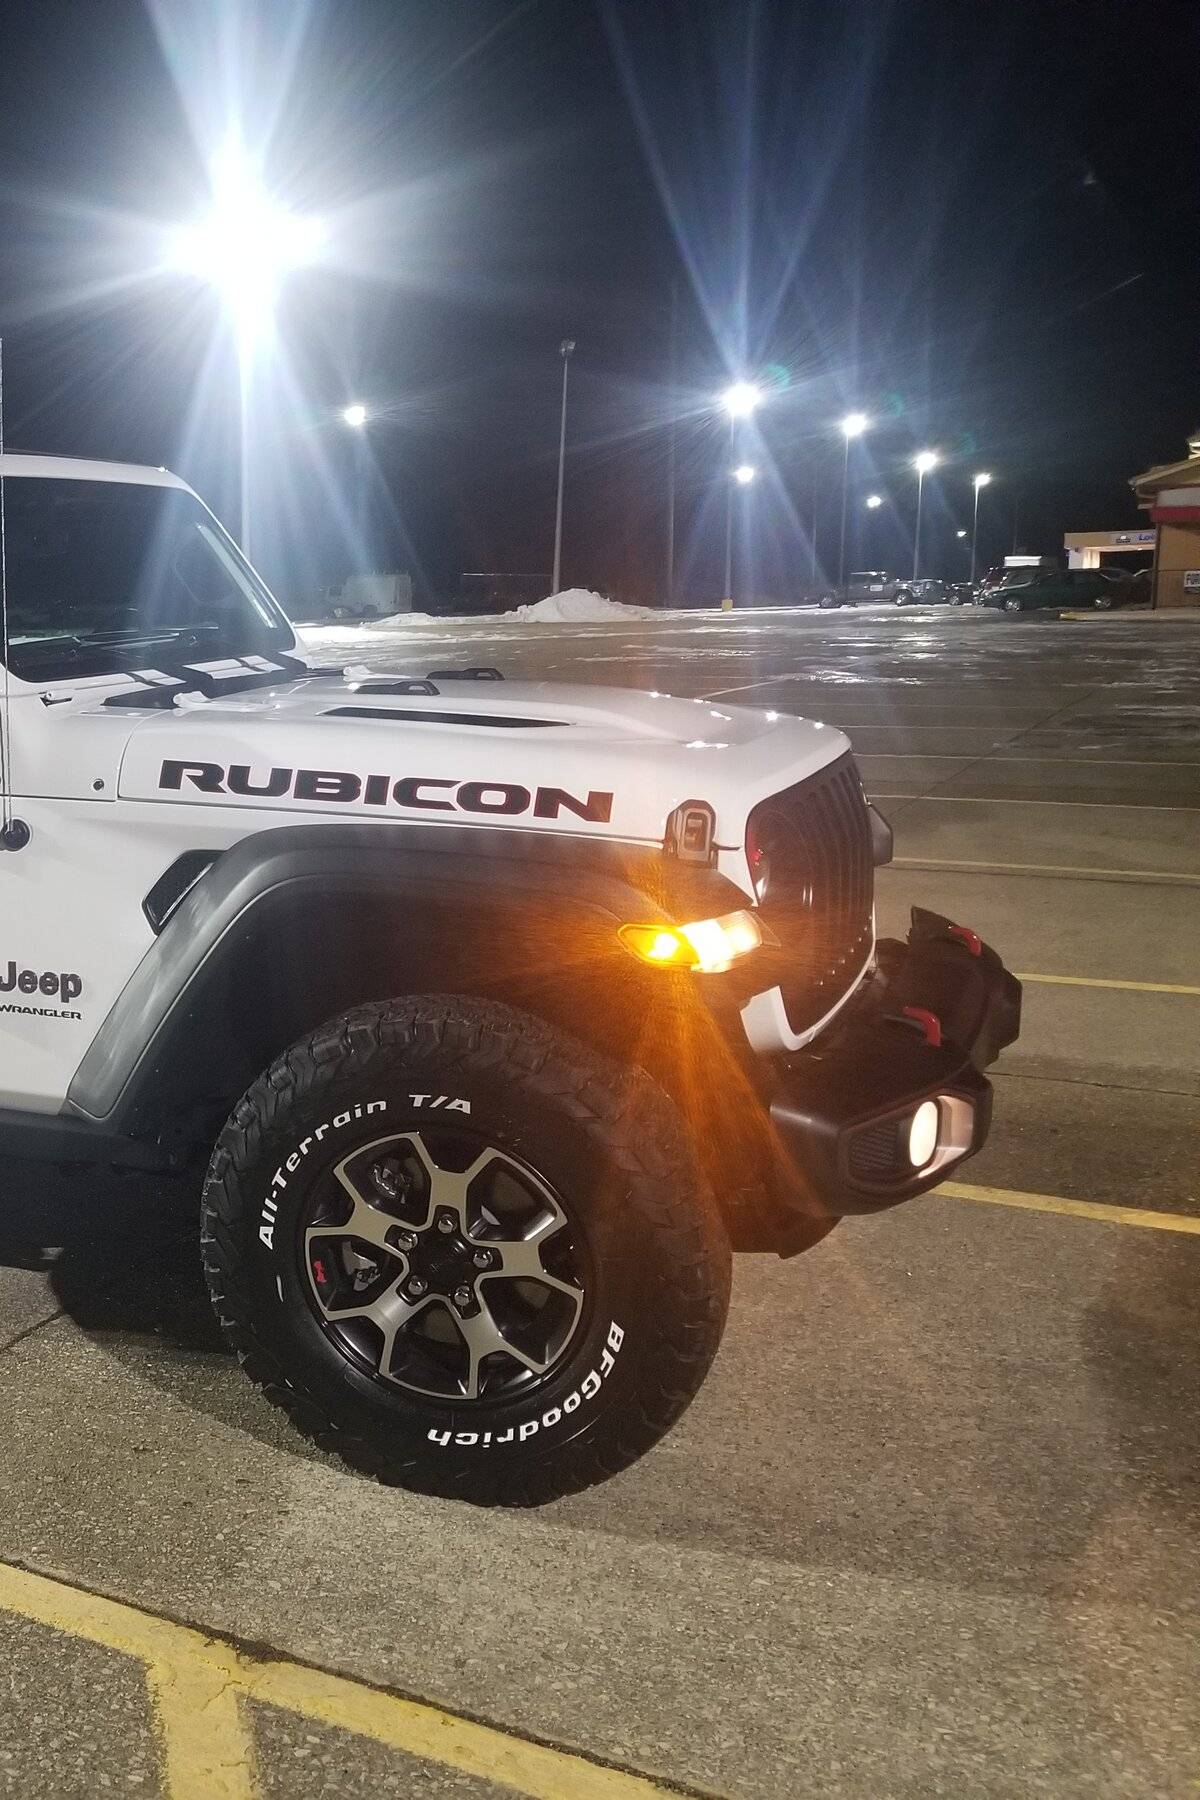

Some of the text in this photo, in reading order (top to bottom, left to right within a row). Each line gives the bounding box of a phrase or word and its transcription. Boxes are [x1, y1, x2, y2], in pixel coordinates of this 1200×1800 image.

[159, 759, 614, 823] RUBICON
[259, 1094, 471, 1250] All-Terrain T/A
[427, 1320, 625, 1448] BFGoodrich
